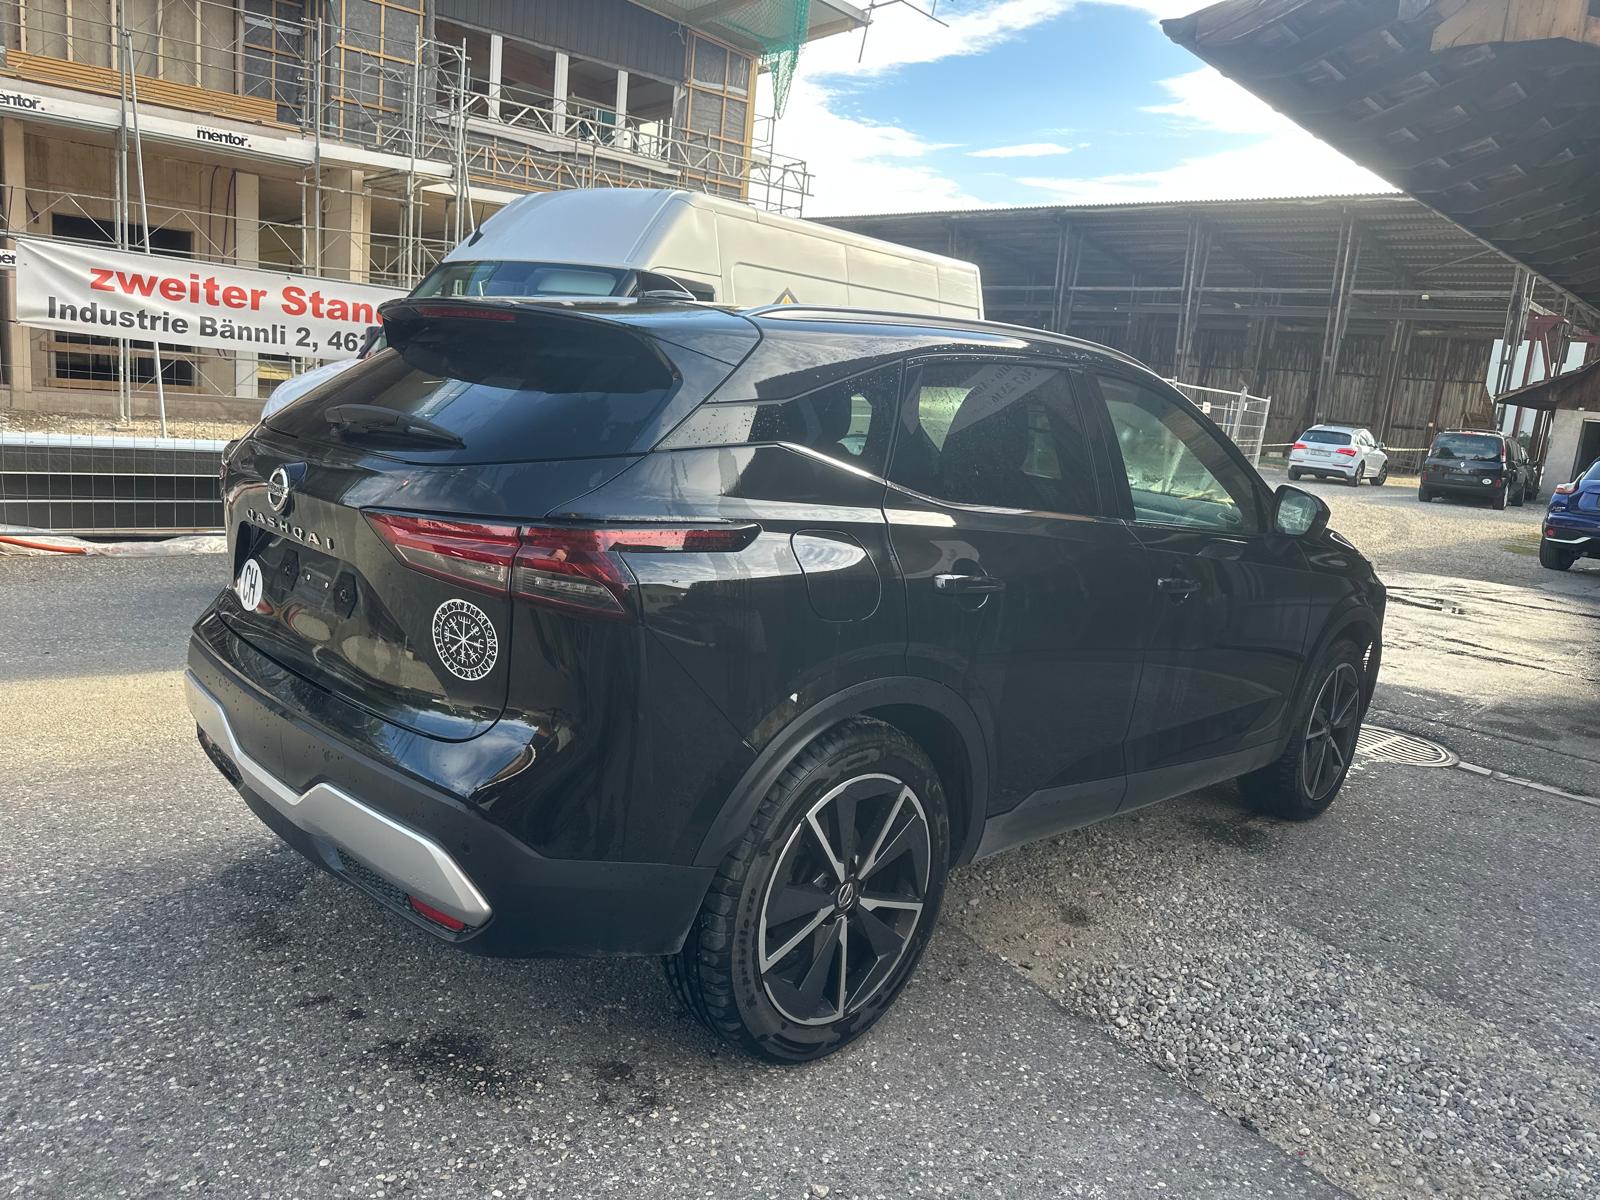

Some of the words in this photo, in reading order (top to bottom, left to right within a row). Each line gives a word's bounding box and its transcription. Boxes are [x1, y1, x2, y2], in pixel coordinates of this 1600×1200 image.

[0, 93, 46, 111] entor.
[196, 129, 252, 148] mentor.
[90, 267, 267, 311] zweiter
[48, 296, 189, 334] Industrie
[199, 316, 287, 345] Bännli
[295, 327, 319, 352] 2,
[327, 330, 366, 352] 46
[246, 508, 335, 550] QASHQAI
[243, 564, 258, 605] CH
